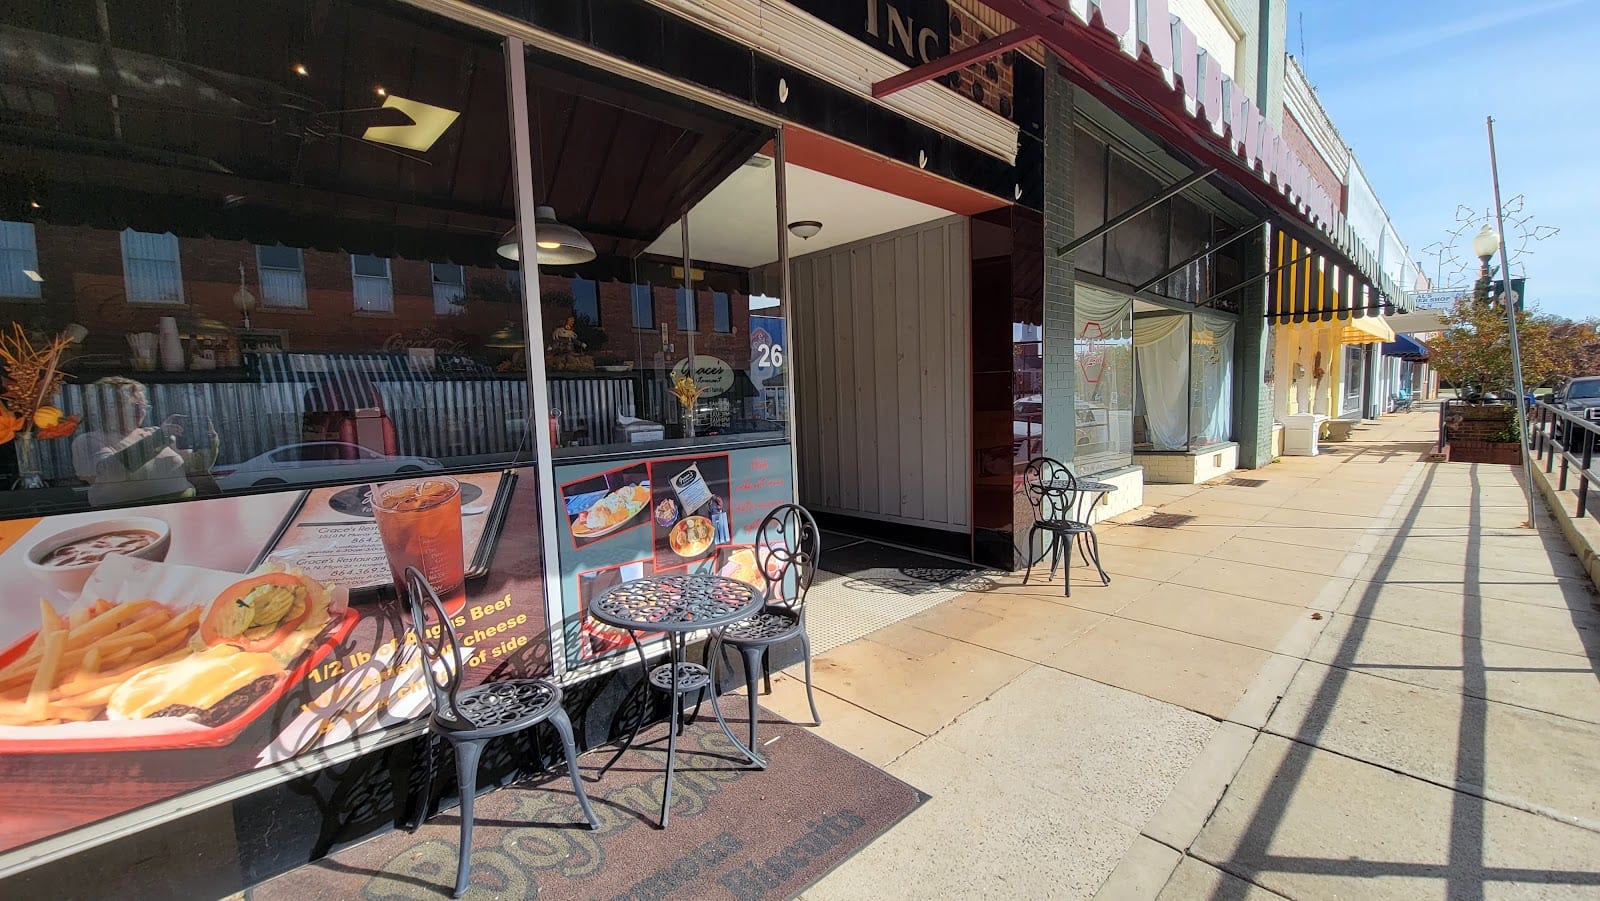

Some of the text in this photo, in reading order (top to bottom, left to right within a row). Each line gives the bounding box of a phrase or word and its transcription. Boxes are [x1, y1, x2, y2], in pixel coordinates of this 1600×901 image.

[680, 359, 725, 377] Gace's
[757, 343, 783, 368] 26
[296, 557, 334, 566] Grace's
[306, 593, 513, 684] 1/2 lb of Agus Beef
[360, 643, 454, 692] Amerin
[463, 613, 529, 648] cheese
[467, 648, 488, 669] of
[492, 634, 530, 658] side
